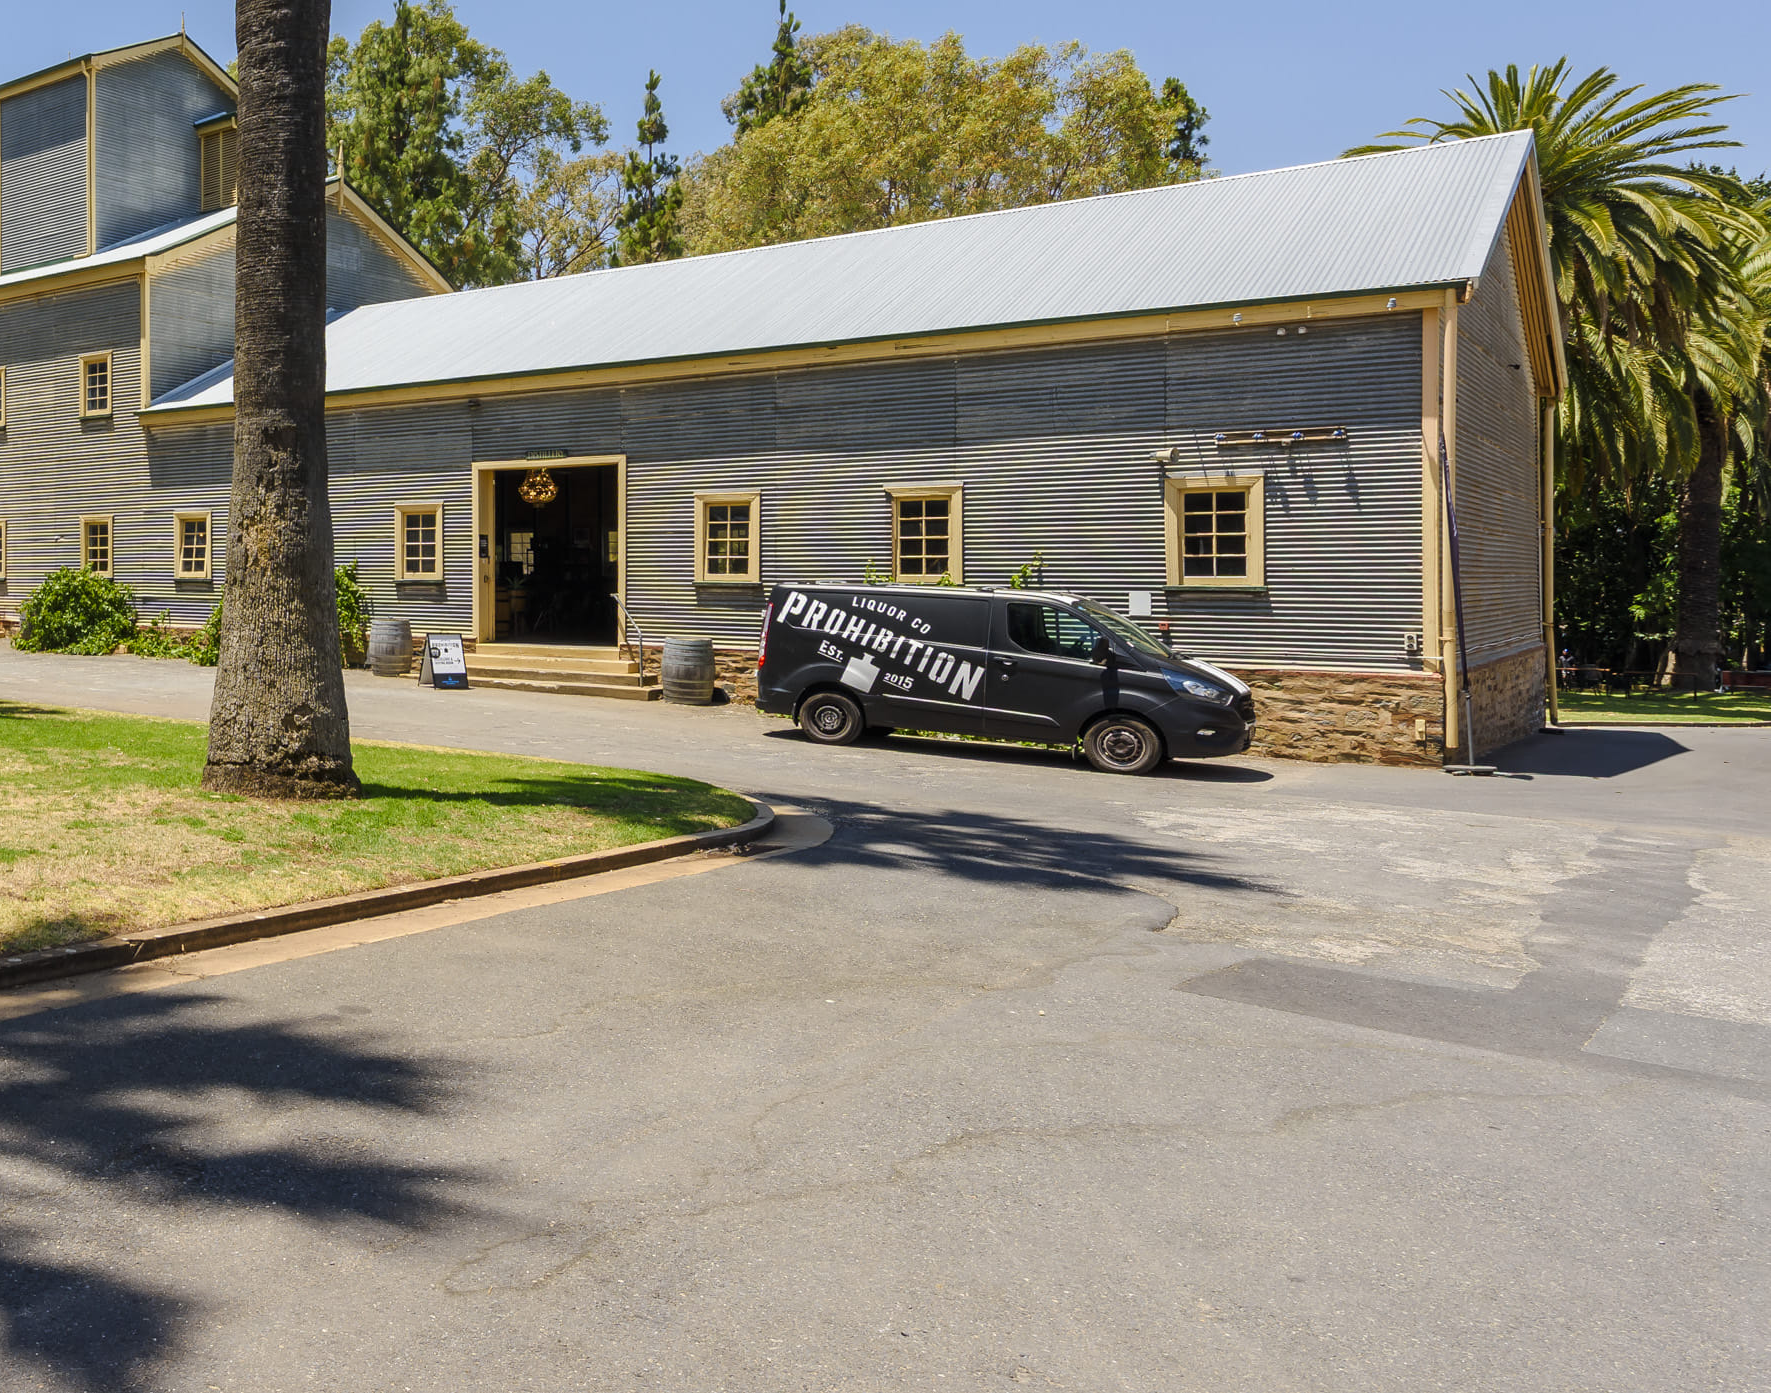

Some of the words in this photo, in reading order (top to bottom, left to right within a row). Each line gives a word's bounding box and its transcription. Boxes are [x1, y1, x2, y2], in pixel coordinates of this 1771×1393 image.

[851, 596, 907, 621] LIQUOR
[911, 617, 932, 635] CO
[776, 591, 985, 701] PROHIBITION
[818, 640, 844, 660] EST.
[883, 671, 915, 690] 2015
